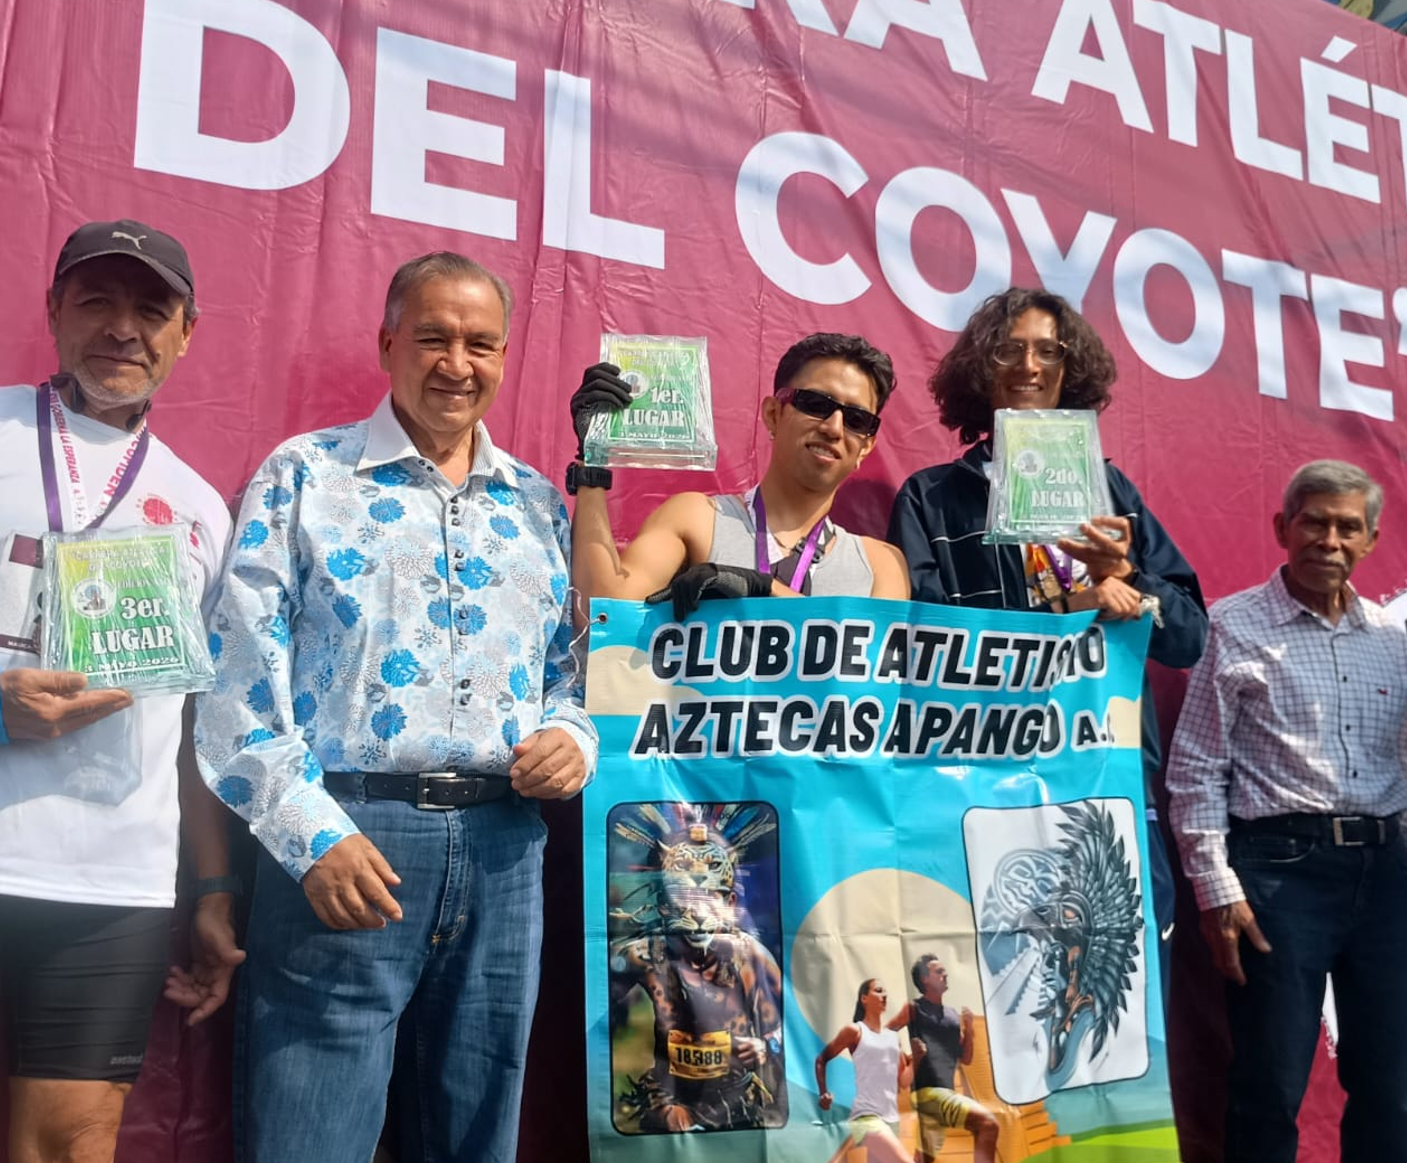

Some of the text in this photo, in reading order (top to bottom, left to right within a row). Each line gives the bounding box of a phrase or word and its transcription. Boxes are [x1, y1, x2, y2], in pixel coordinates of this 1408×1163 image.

[134, 0, 665, 270] DEL
[624, 409, 685, 426] LUGAR
[1032, 490, 1084, 507] LUGAR
[121, 597, 170, 620] 3er.
[92, 625, 174, 655] LUGAR
[652, 624, 790, 680] CLUB
[803, 625, 868, 676] DE
[635, 701, 879, 755] AZTECAS
[883, 702, 1061, 757] APANGO
